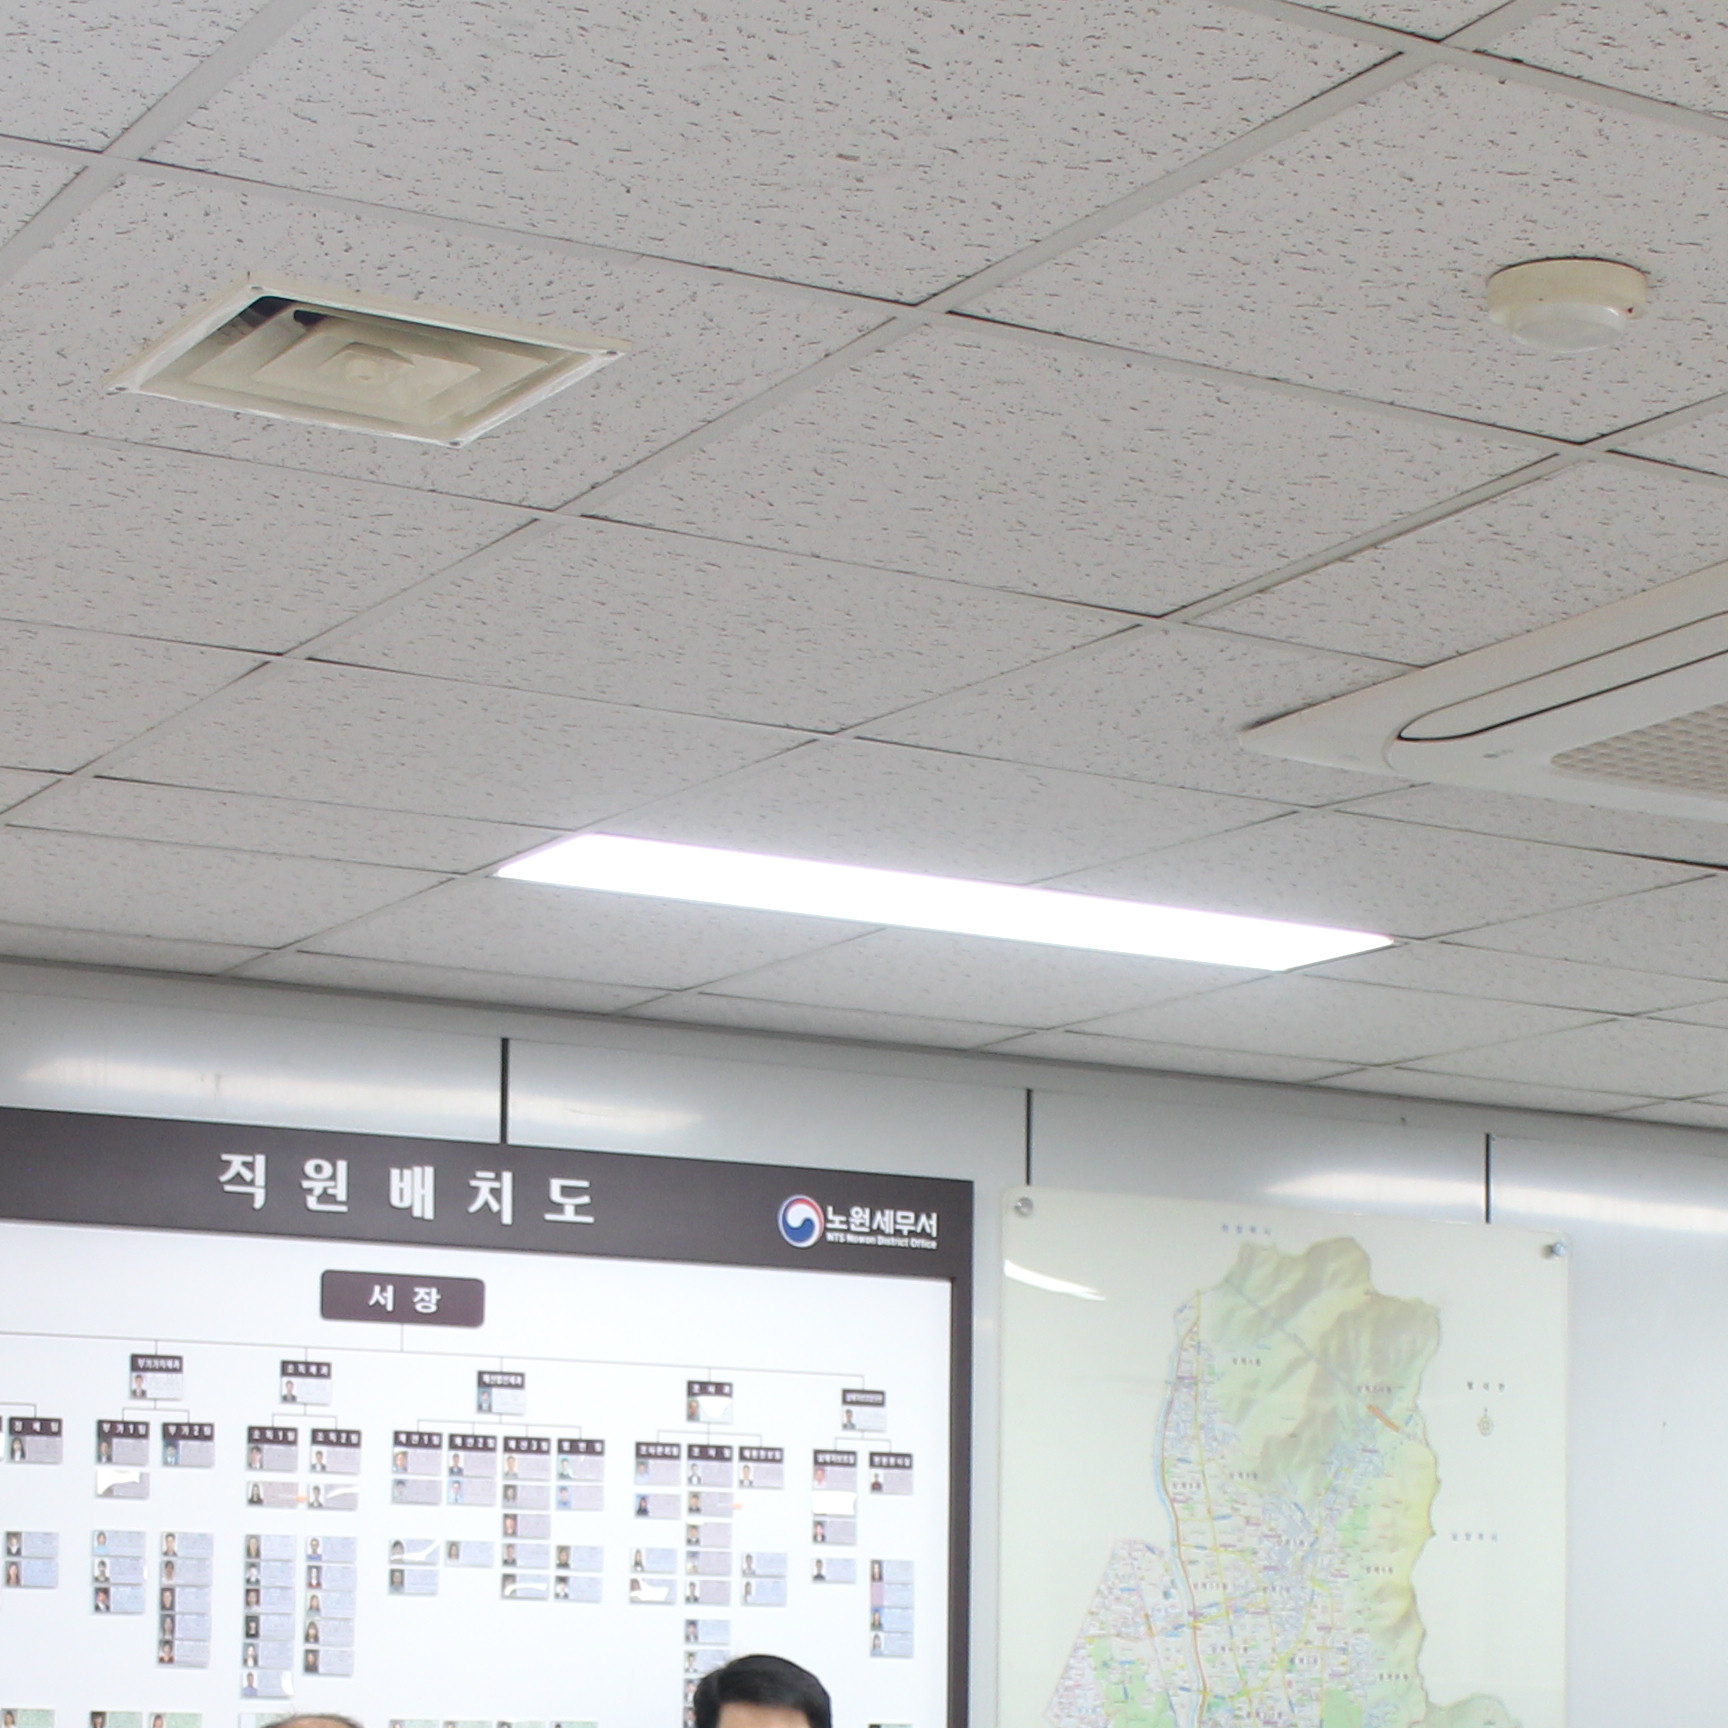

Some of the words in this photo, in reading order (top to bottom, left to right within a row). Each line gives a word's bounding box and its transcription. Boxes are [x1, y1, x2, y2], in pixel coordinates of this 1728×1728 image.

[826, 1205, 938, 1238] 노원세무서
[826, 1232, 845, 1243] NTS
[846, 1234, 877, 1246] Nowon
[877, 1236, 909, 1248] District
[910, 1238, 938, 1250] Office
[369, 1283, 441, 1314] 서장
